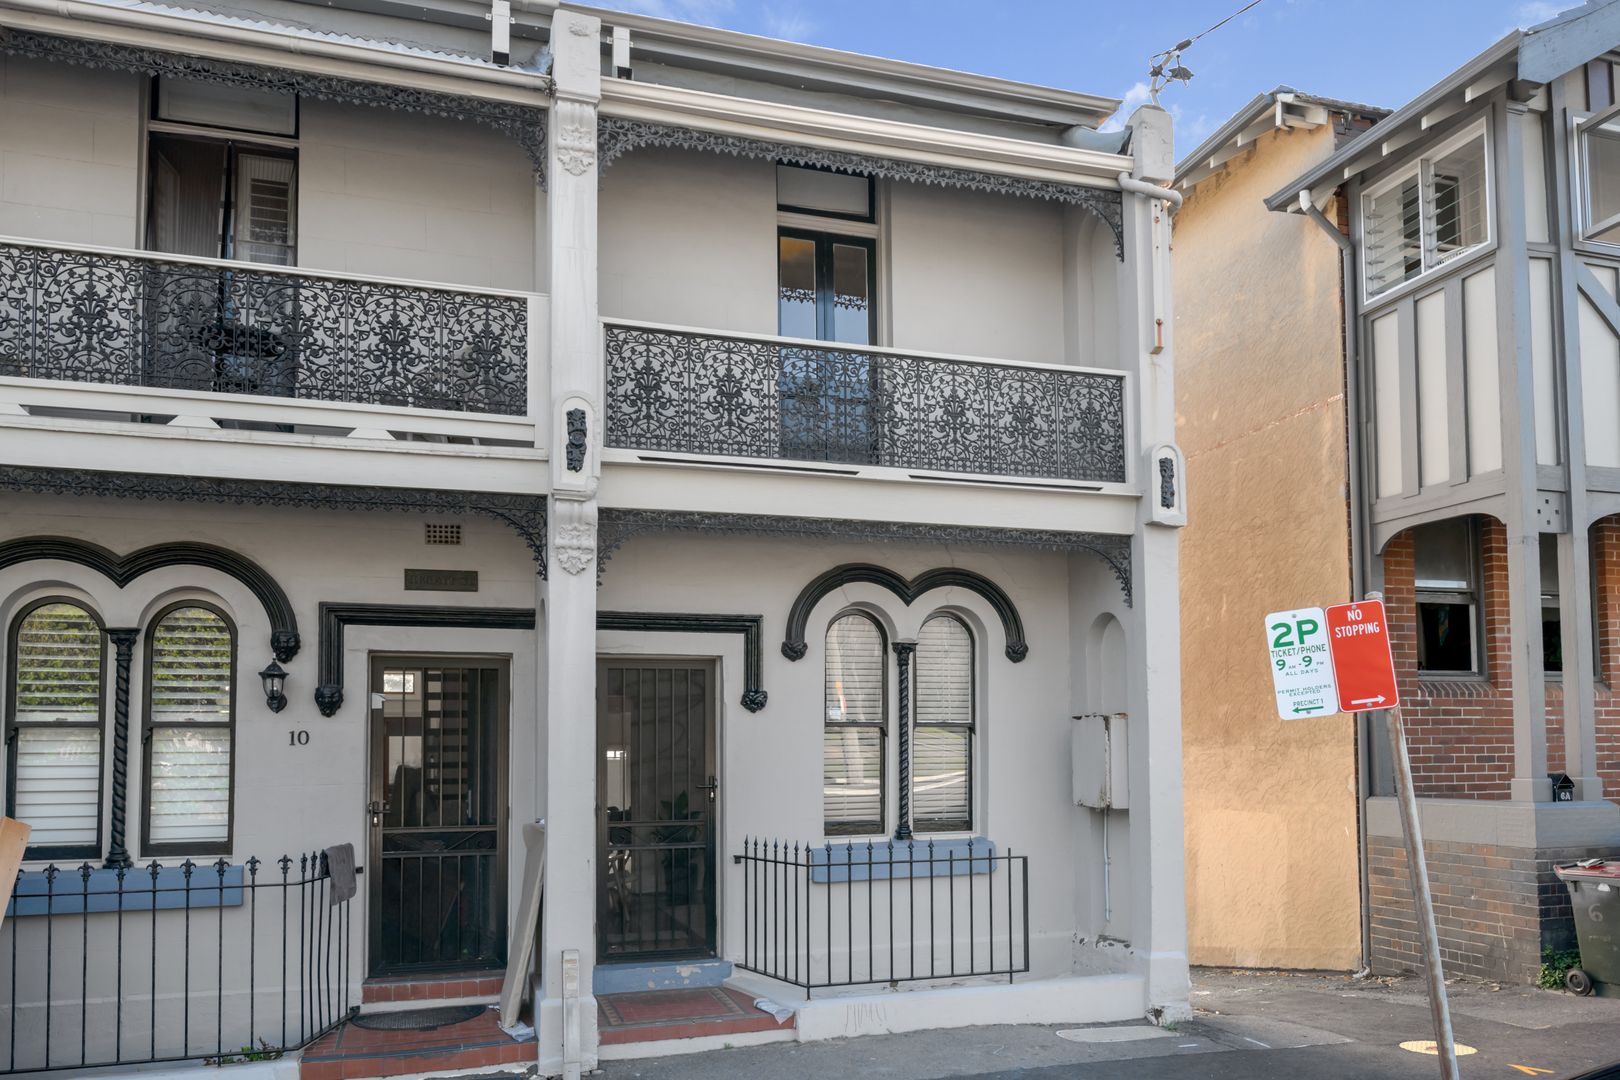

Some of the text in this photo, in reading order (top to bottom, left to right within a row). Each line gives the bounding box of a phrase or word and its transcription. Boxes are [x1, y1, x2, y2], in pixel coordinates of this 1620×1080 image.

[1347, 609, 1362, 621] NO
[1271, 619, 1318, 648] 2P
[1335, 622, 1380, 638] STOPPING
[1271, 644, 1326, 658] TICKET/PHONE
[1276, 659, 1286, 671] 9
[1293, 698, 1319, 707] PRECINCT
[289, 730, 309, 746] 10
[1560, 792, 1571, 800] 6A
[1588, 903, 1603, 922] 6
